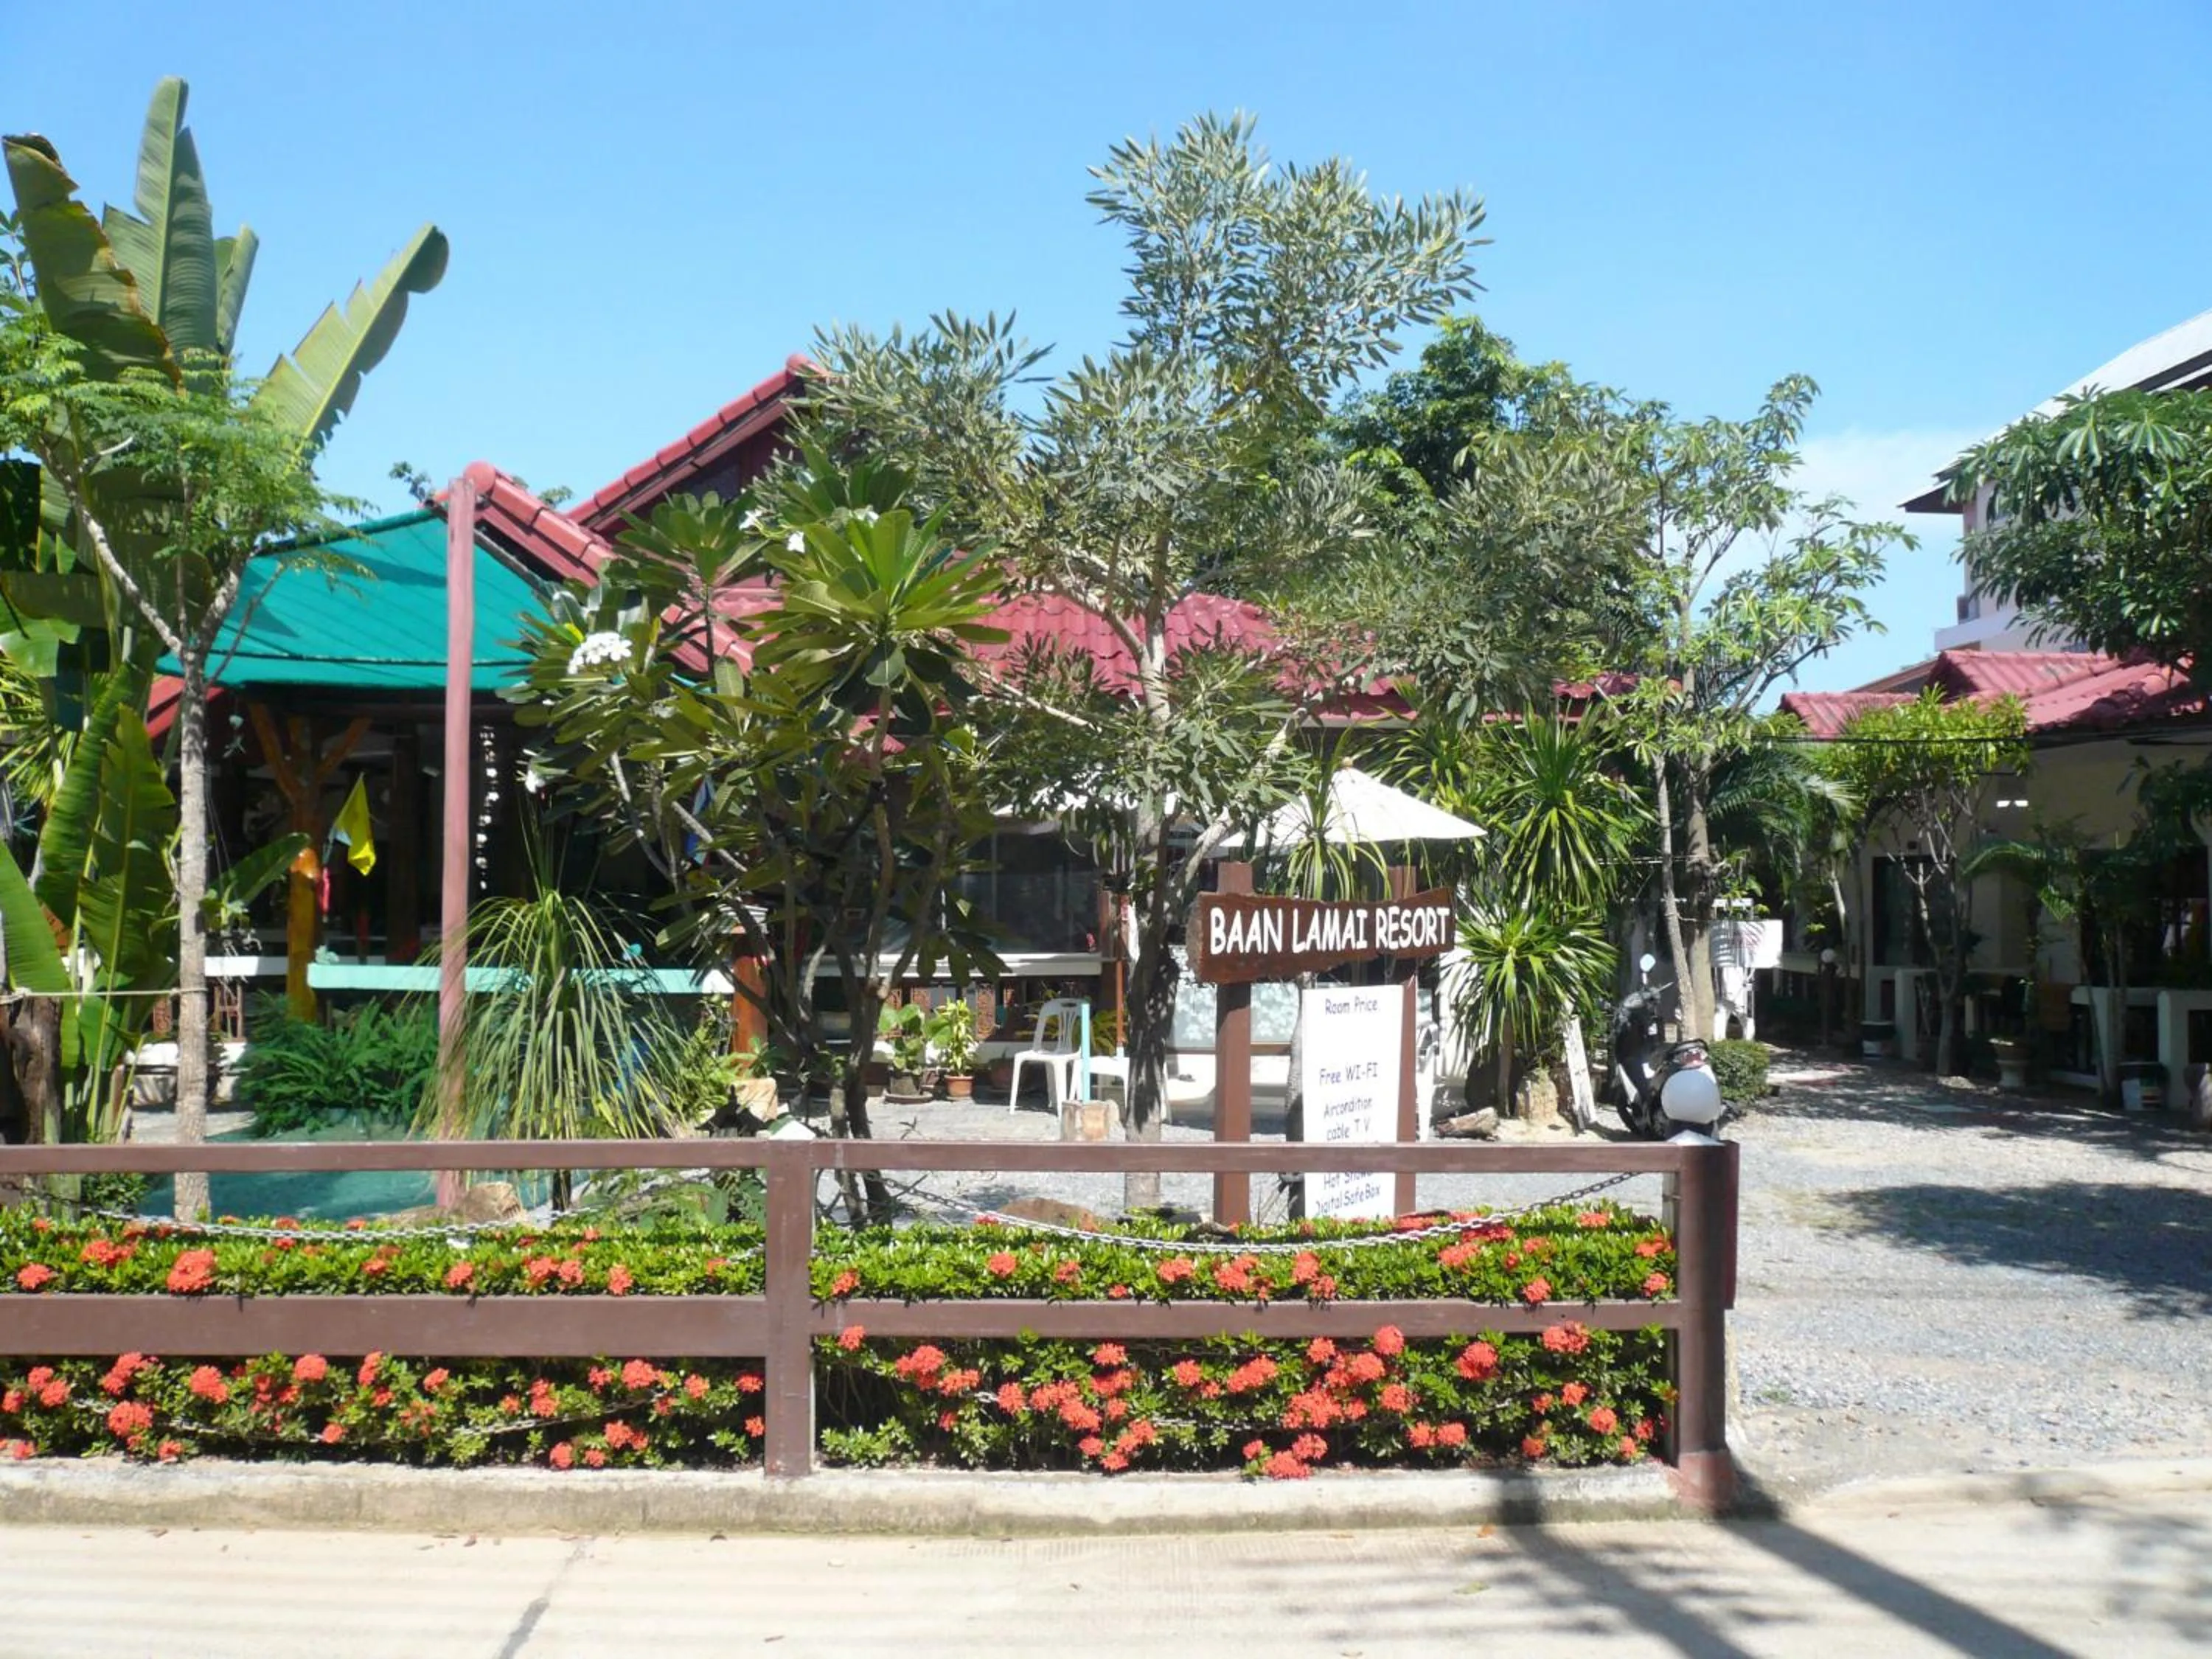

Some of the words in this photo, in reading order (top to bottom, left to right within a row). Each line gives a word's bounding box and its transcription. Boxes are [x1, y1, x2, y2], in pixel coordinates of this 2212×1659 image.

[1210, 907, 1284, 956] BAAN
[1292, 908, 1368, 953] LAMAI
[1375, 906, 1451, 950] RESORT
[1325, 998, 1350, 1015] Room
[1319, 1068, 1342, 1086] Free
[1345, 1062, 1378, 1081] WI-FI
[1326, 1122, 1350, 1141] cable
